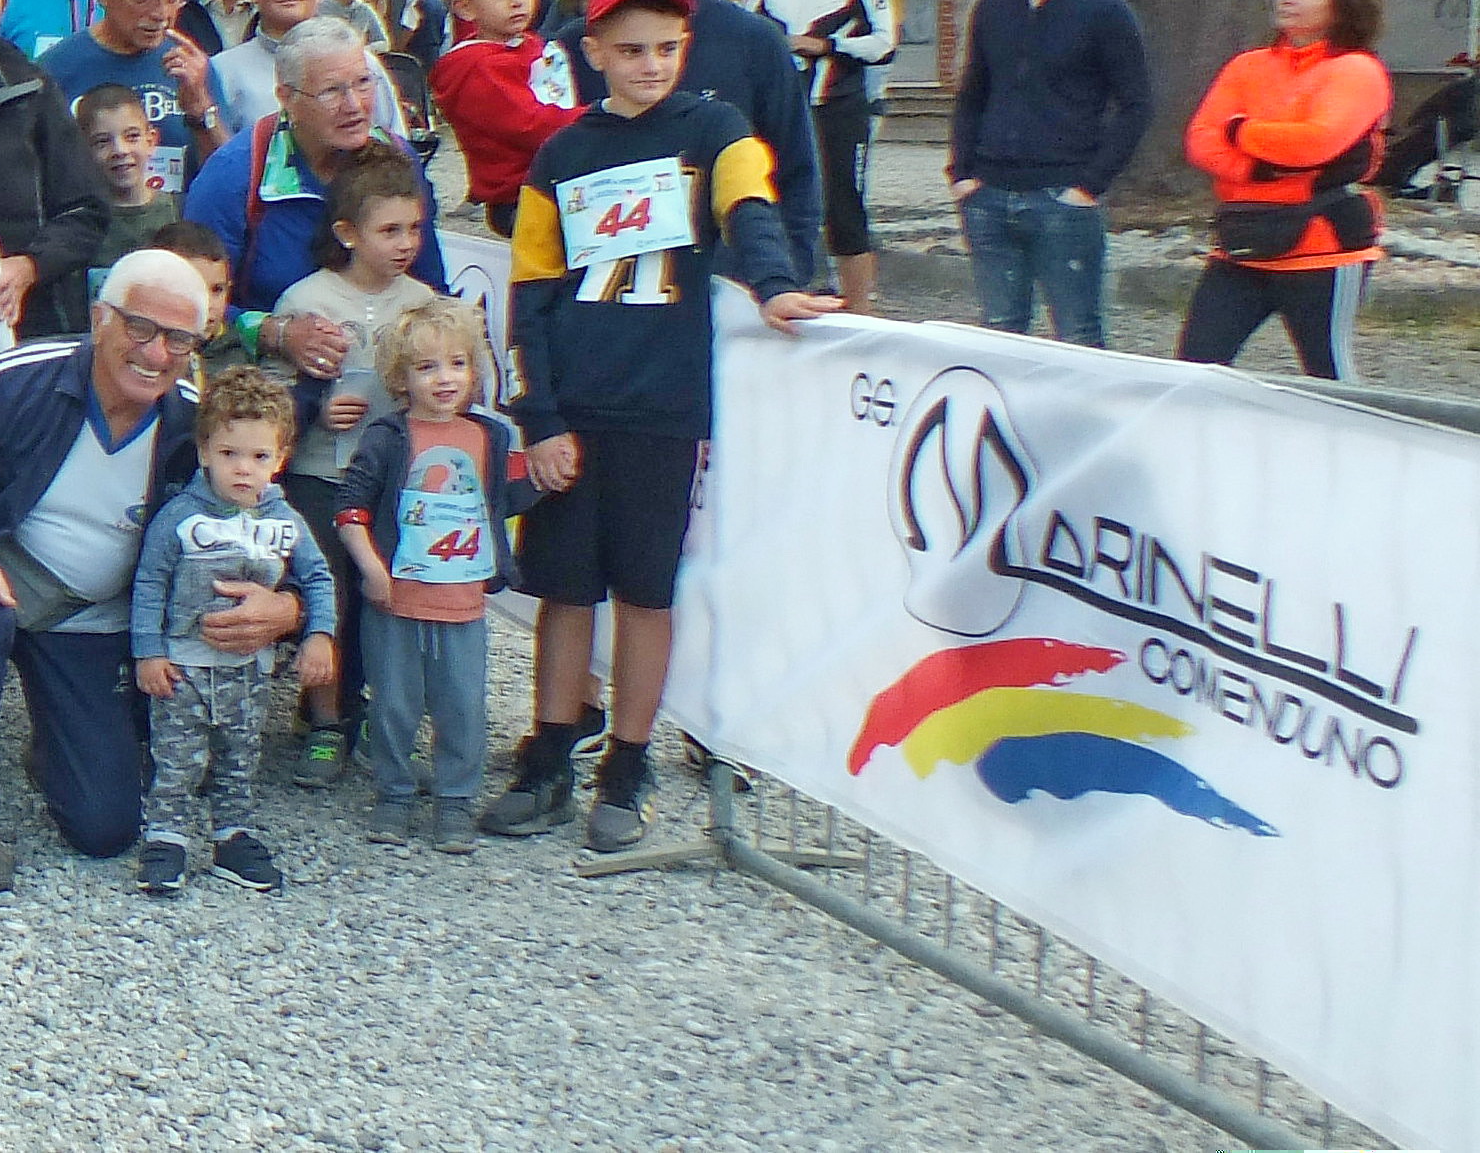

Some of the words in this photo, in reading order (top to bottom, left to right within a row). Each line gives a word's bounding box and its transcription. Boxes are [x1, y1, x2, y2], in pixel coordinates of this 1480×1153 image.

[594, 197, 652, 237] 44
[427, 526, 481, 562] 44
[900, 396, 1420, 732] MARINELLI
[1140, 637, 1405, 789] COMENDUNO
